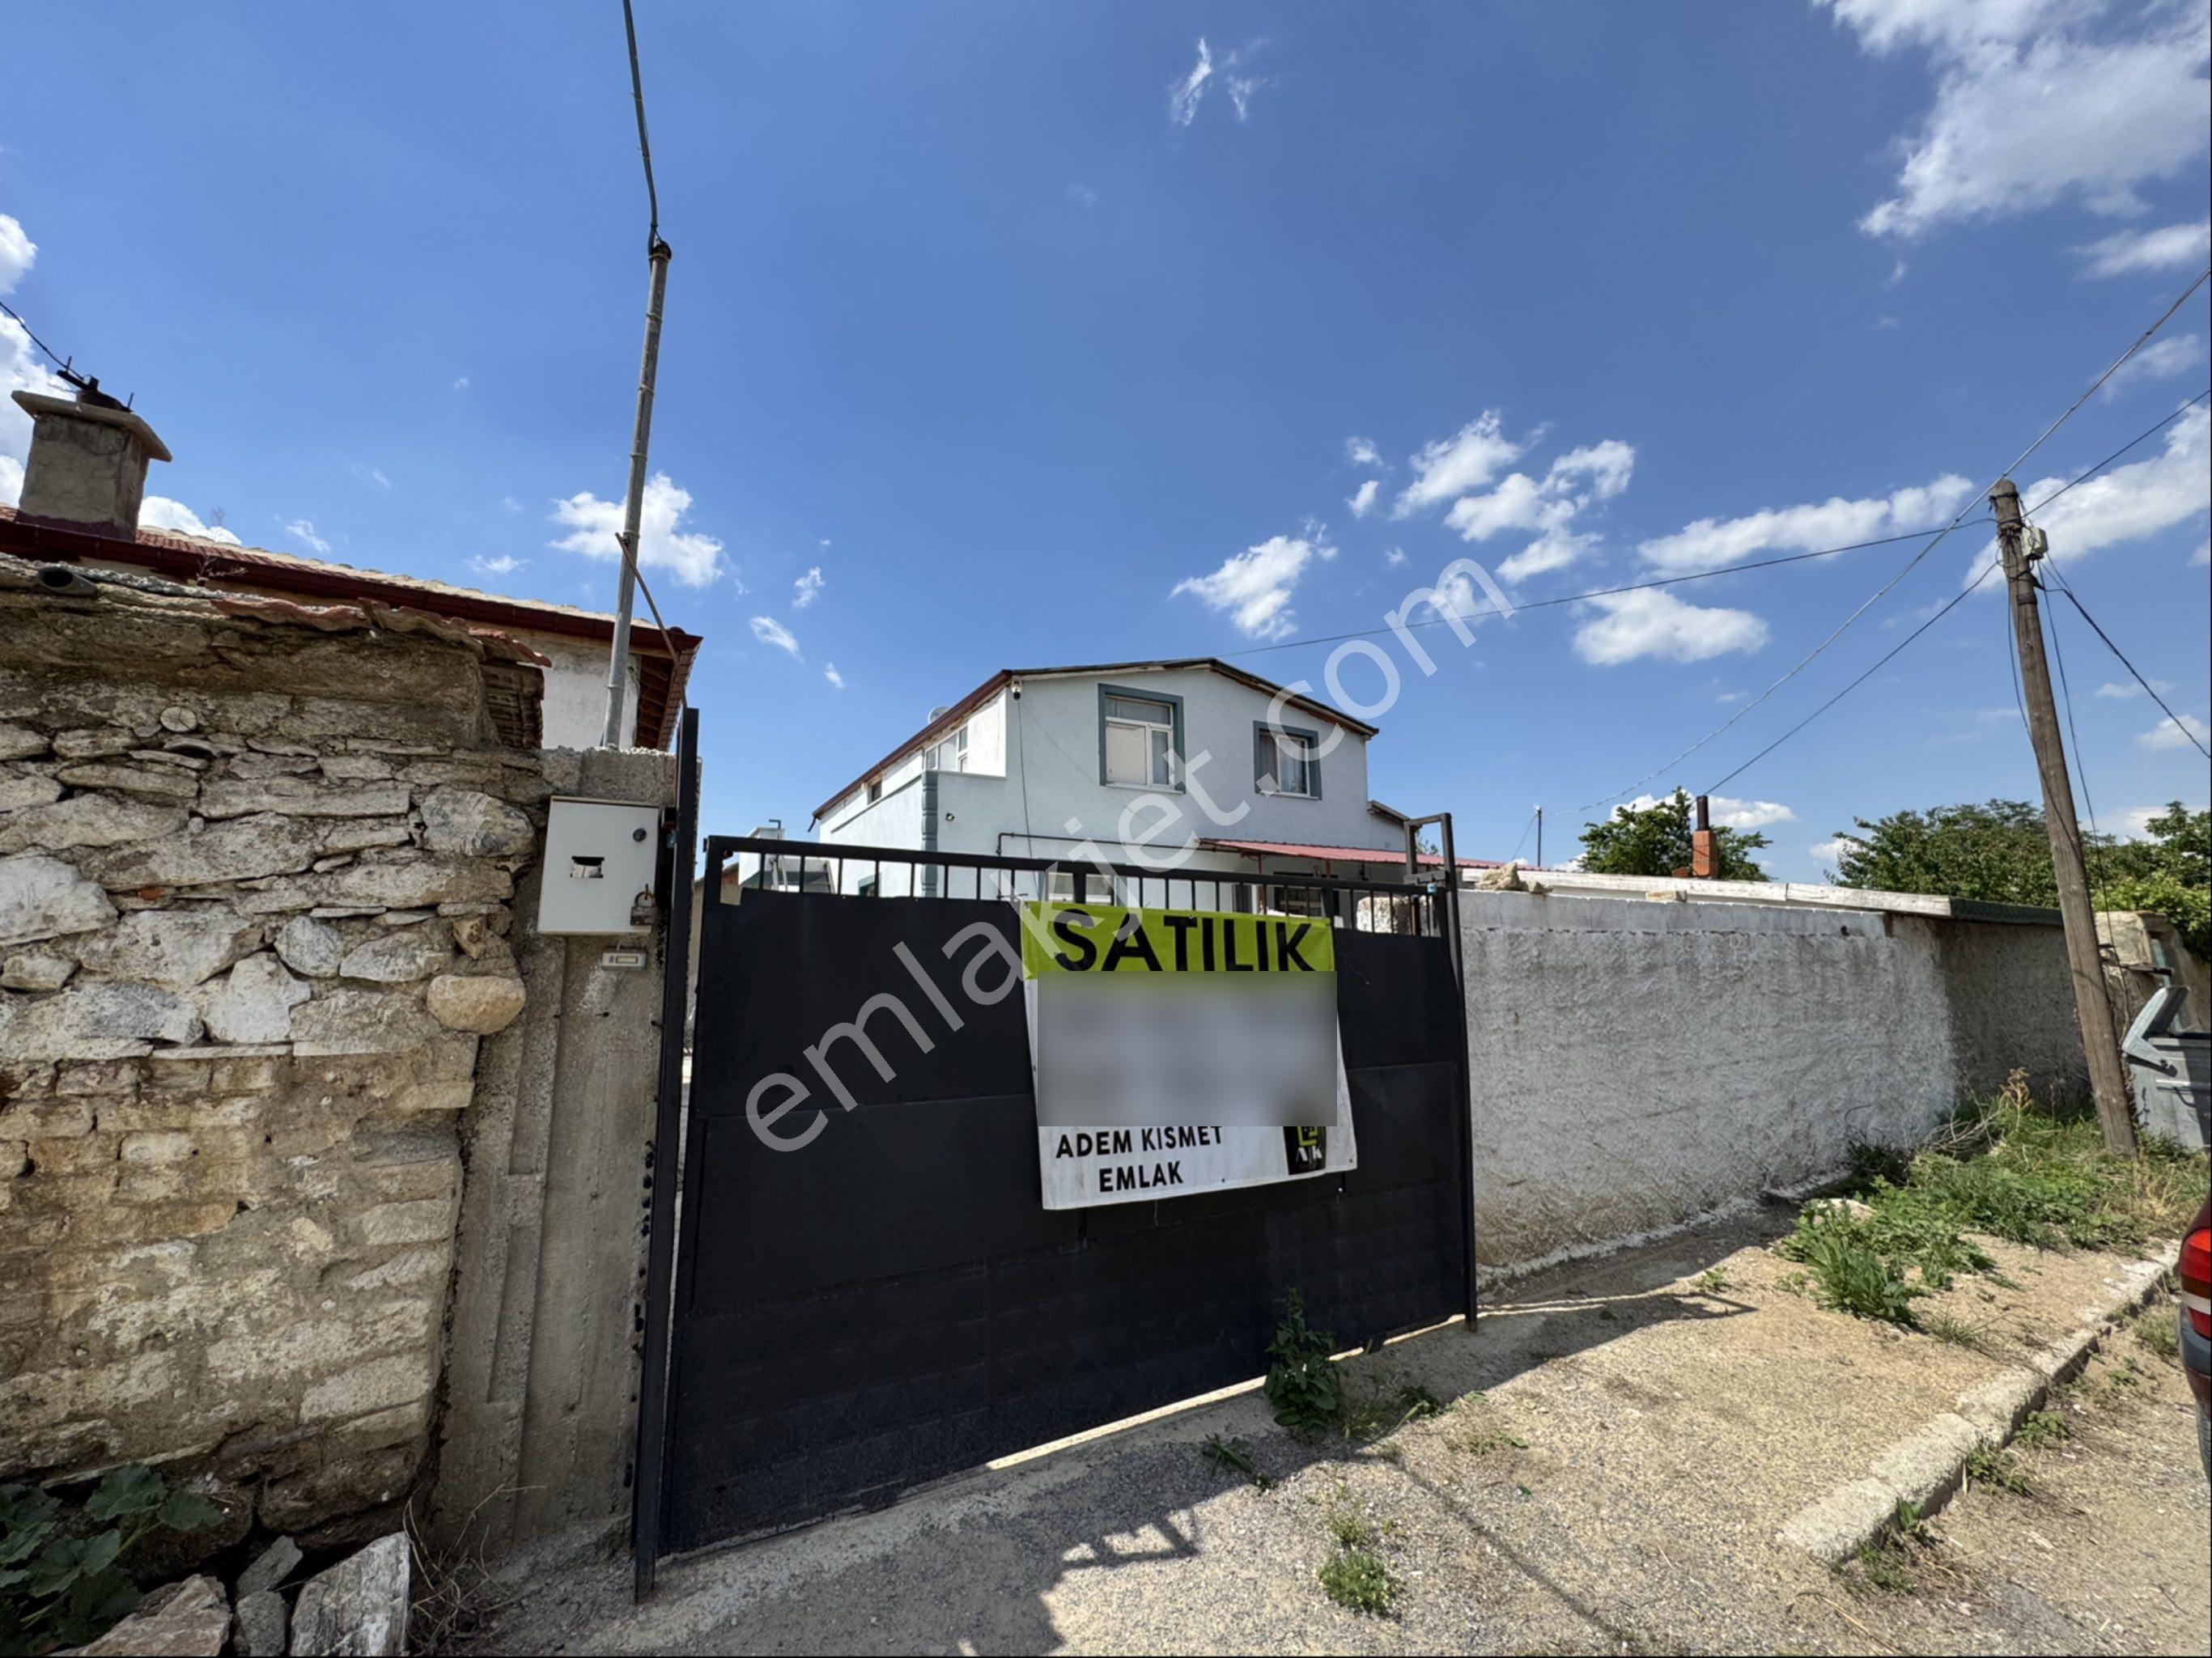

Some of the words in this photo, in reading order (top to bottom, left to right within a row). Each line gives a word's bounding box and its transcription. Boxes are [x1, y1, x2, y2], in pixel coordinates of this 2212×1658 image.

[1054, 908, 1316, 971] SATILIK
[1055, 1130, 1132, 1158] ADEM
[1141, 1126, 1222, 1151] KISMET
[1099, 1160, 1183, 1192] EMLAK
